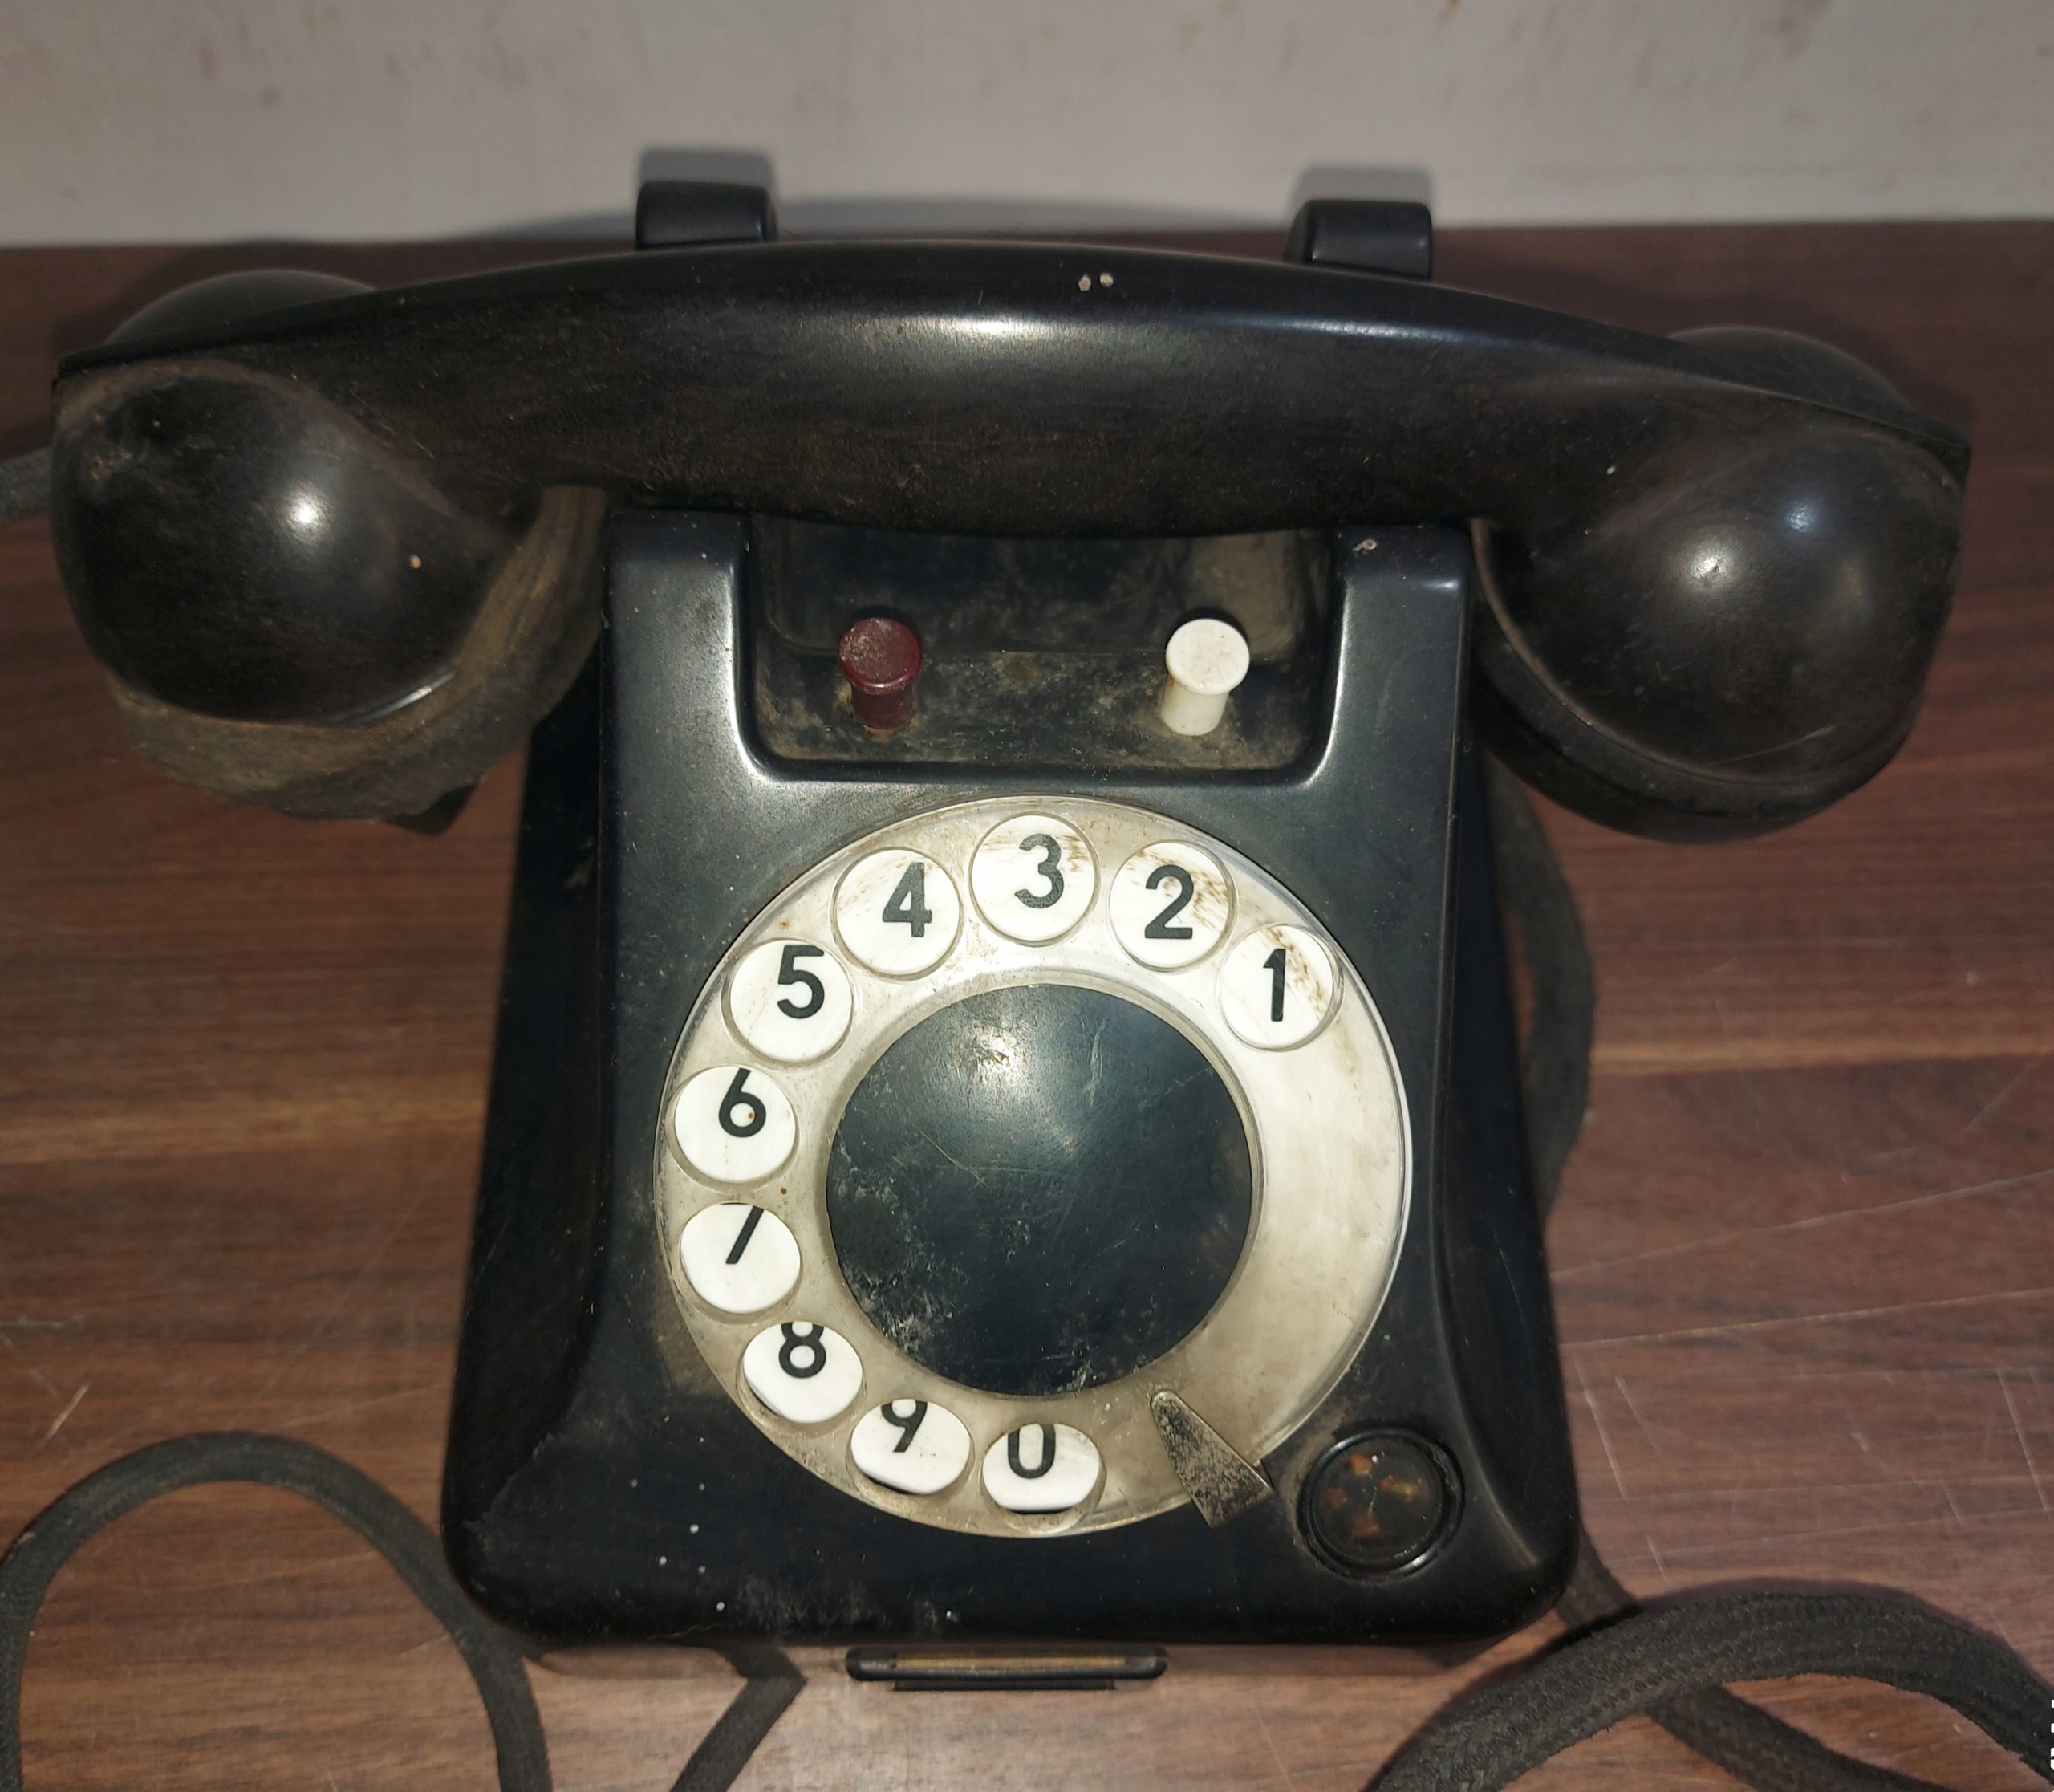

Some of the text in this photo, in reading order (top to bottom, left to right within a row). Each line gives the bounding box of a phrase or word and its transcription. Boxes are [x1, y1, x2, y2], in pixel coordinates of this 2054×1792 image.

[883, 862, 932, 937] 4
[1014, 834, 1064, 908] 3
[1145, 865, 1194, 939] 2
[777, 945, 825, 1019] 5
[1263, 949, 1285, 1022] 1
[719, 1068, 766, 1138] 6
[778, 1322, 826, 1379] 8
[881, 1399, 928, 1453] 9
